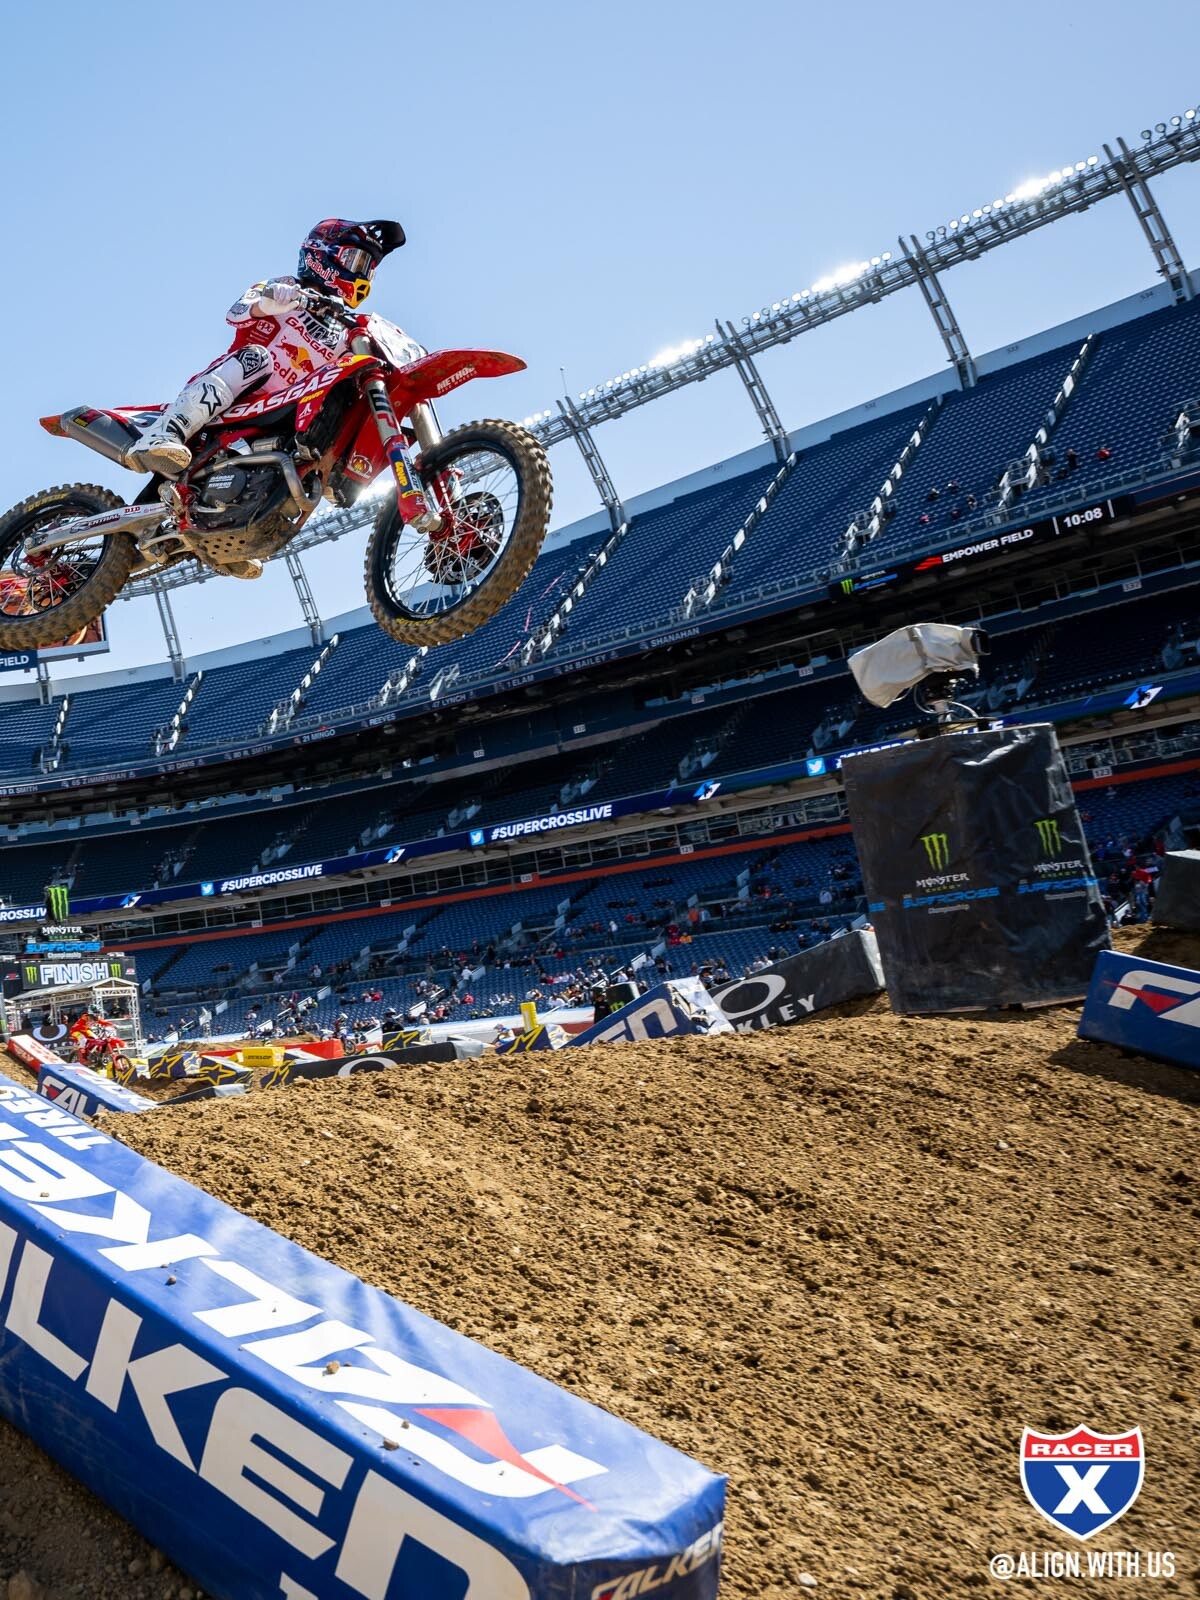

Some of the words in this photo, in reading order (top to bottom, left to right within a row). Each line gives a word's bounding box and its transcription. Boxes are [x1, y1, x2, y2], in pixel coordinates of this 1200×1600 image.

[285, 316, 334, 361] GASGAS
[436, 366, 475, 391] METHOD
[223, 368, 343, 418] GASGAS
[1063, 508, 1103, 528] 10:08
[942, 540, 999, 563] EMPOWER
[1000, 529, 1034, 546] FIELD
[650, 627, 700, 647] SHANAHAN
[511, 674, 534, 687] ELAM
[491, 804, 612, 840] #SUPERCROSSLIVE
[1034, 859, 1084, 873] MONSTER
[220, 864, 322, 892] #SUPERCROSSLIVE
[916, 872, 970, 888] MONSTER
[903, 887, 1000, 909] SUPERCROSS
[42, 926, 83, 935] MONSTER
[25, 941, 102, 953] SUPERCROSS
[40, 963, 108, 985] FINISH
[736, 994, 816, 1033] KLEY
